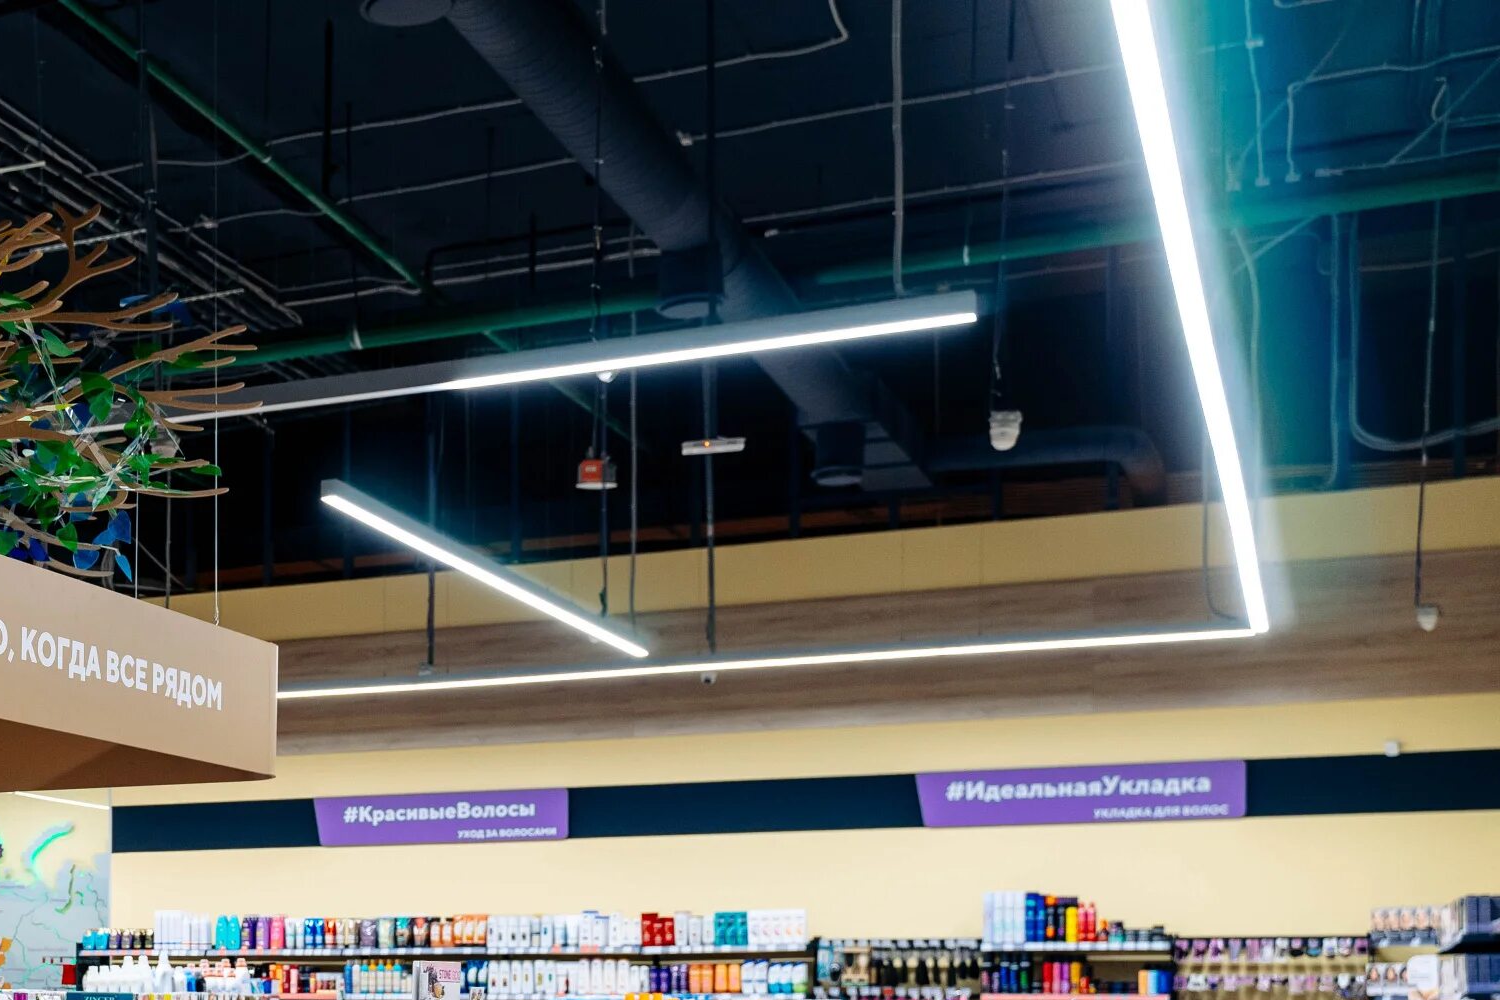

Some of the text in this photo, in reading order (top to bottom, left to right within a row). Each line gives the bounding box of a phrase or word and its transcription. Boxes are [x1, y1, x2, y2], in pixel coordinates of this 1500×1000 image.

[20, 626, 101, 682] КОГДА
[106, 650, 148, 692] ВСЕ
[152, 662, 223, 711] РЯДОМ
[945, 774, 1211, 803] #ИдеальнаяУкладка
[343, 801, 536, 826] #КрасивыеВолосы
[457, 829, 485, 839] УХОД
[499, 826, 557, 838] ВОЛОСАМИ
